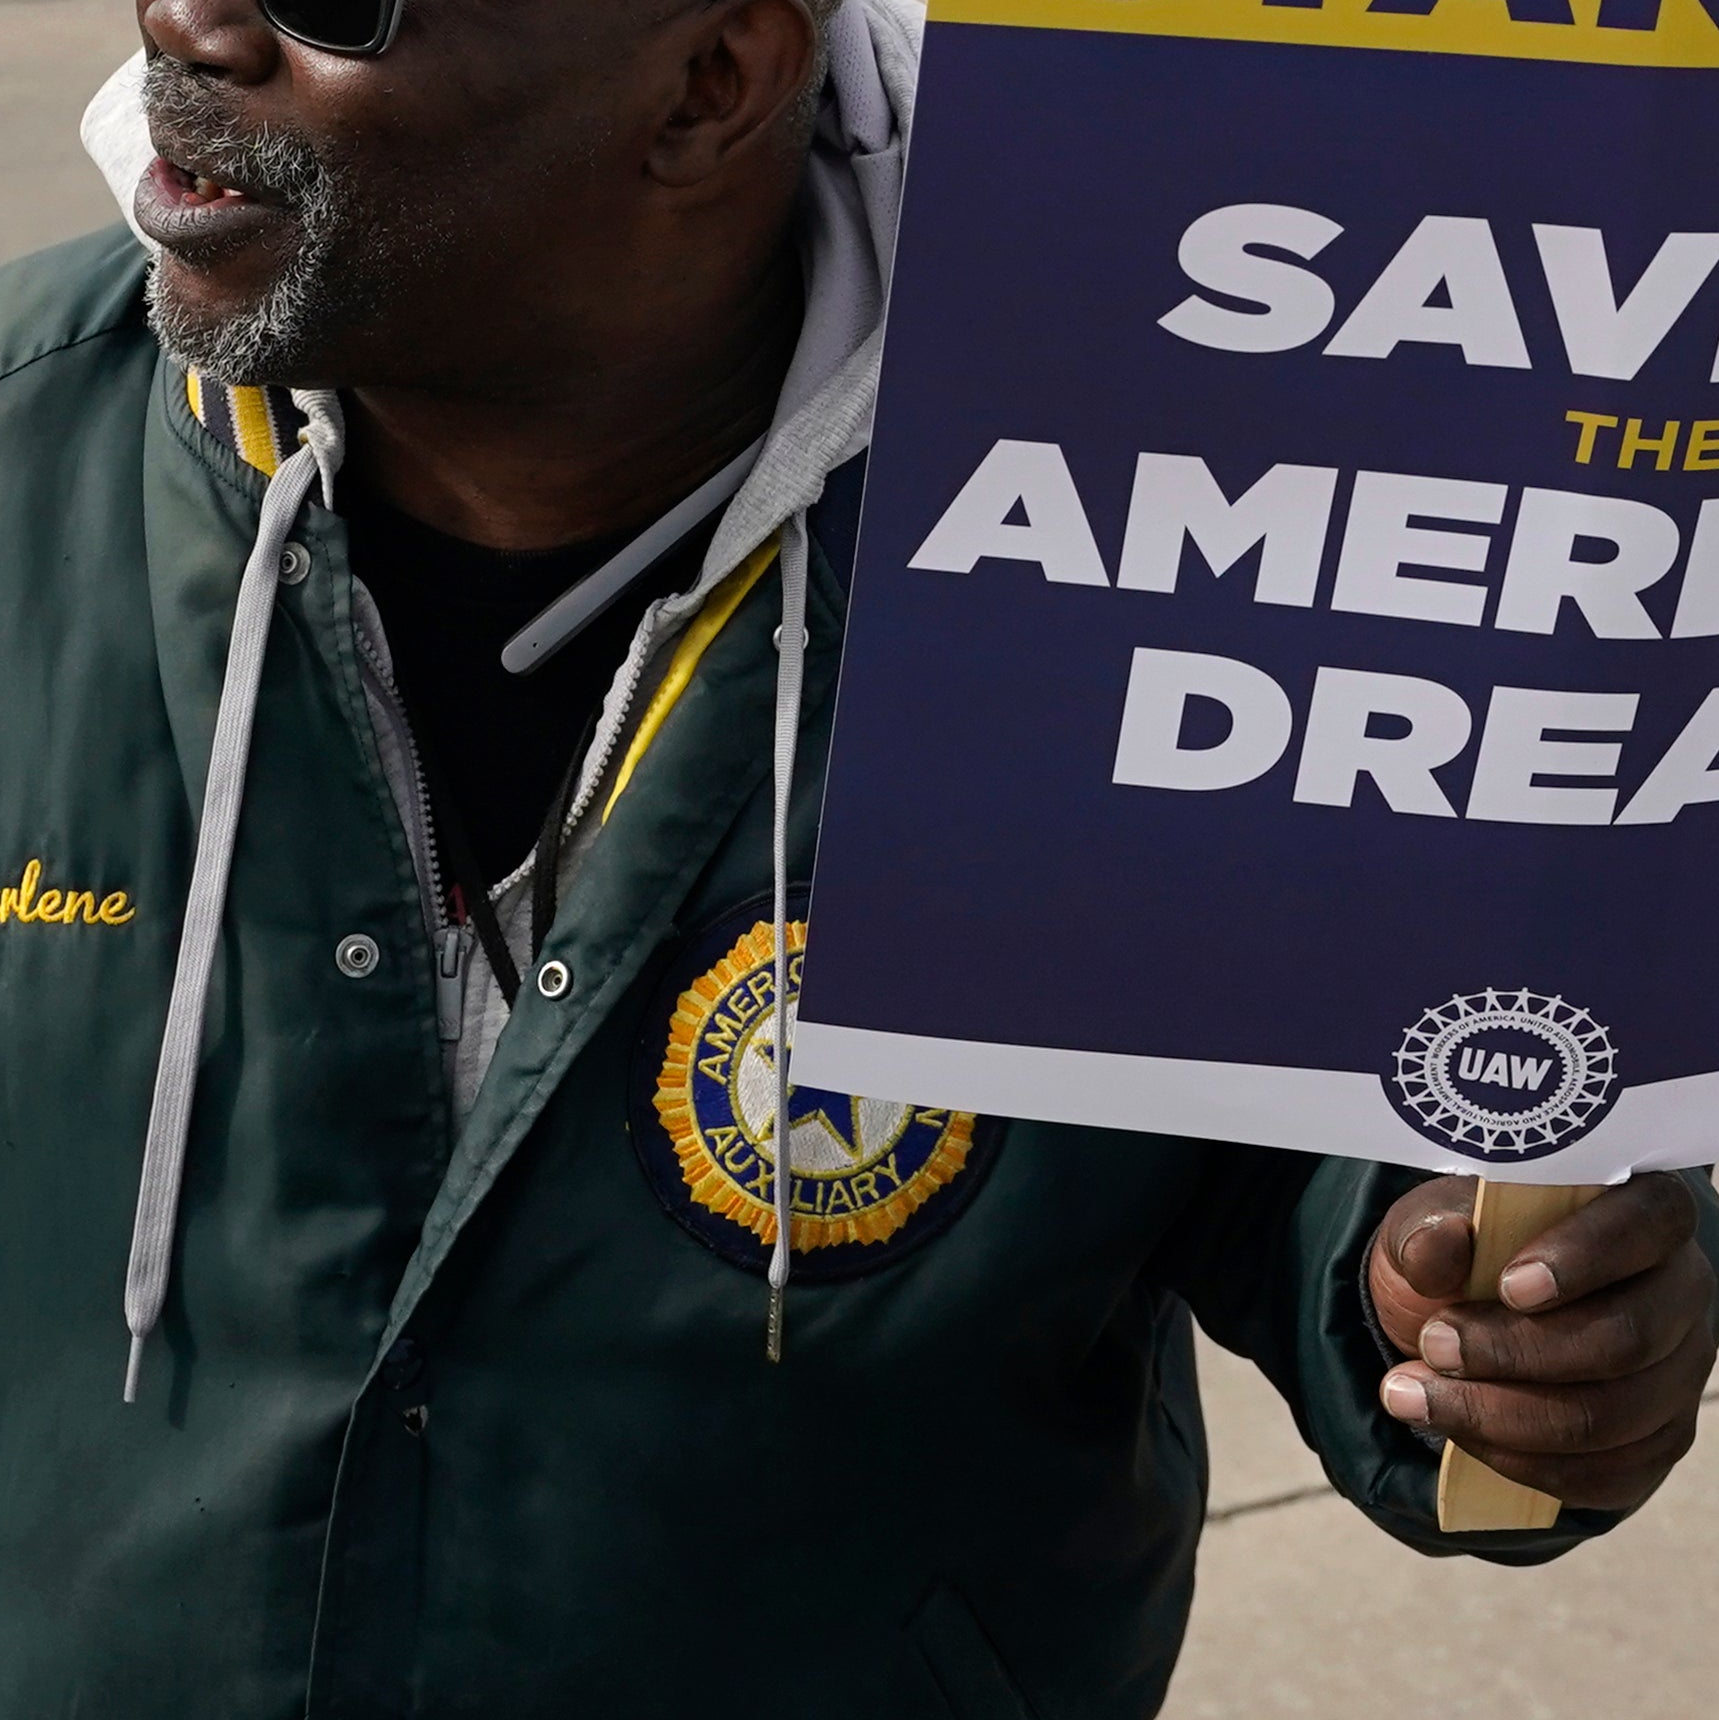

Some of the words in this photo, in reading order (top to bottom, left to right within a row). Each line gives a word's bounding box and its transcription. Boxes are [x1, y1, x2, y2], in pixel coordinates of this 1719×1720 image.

[1458, 1022, 1470, 1031] OF
[1472, 1015, 1516, 1025] AMERICA
[1520, 1017, 1553, 1033] UNITED
[1430, 1028, 1459, 1059] WORKERS
[1459, 1048, 1553, 1091] UAW
[1543, 1078, 1578, 1116] AEROSPACE
[1452, 1101, 1520, 1127] AGRICULTURAL
[1523, 1113, 1543, 1125] AND
[704, 1125, 902, 1214] AUXLIARY
